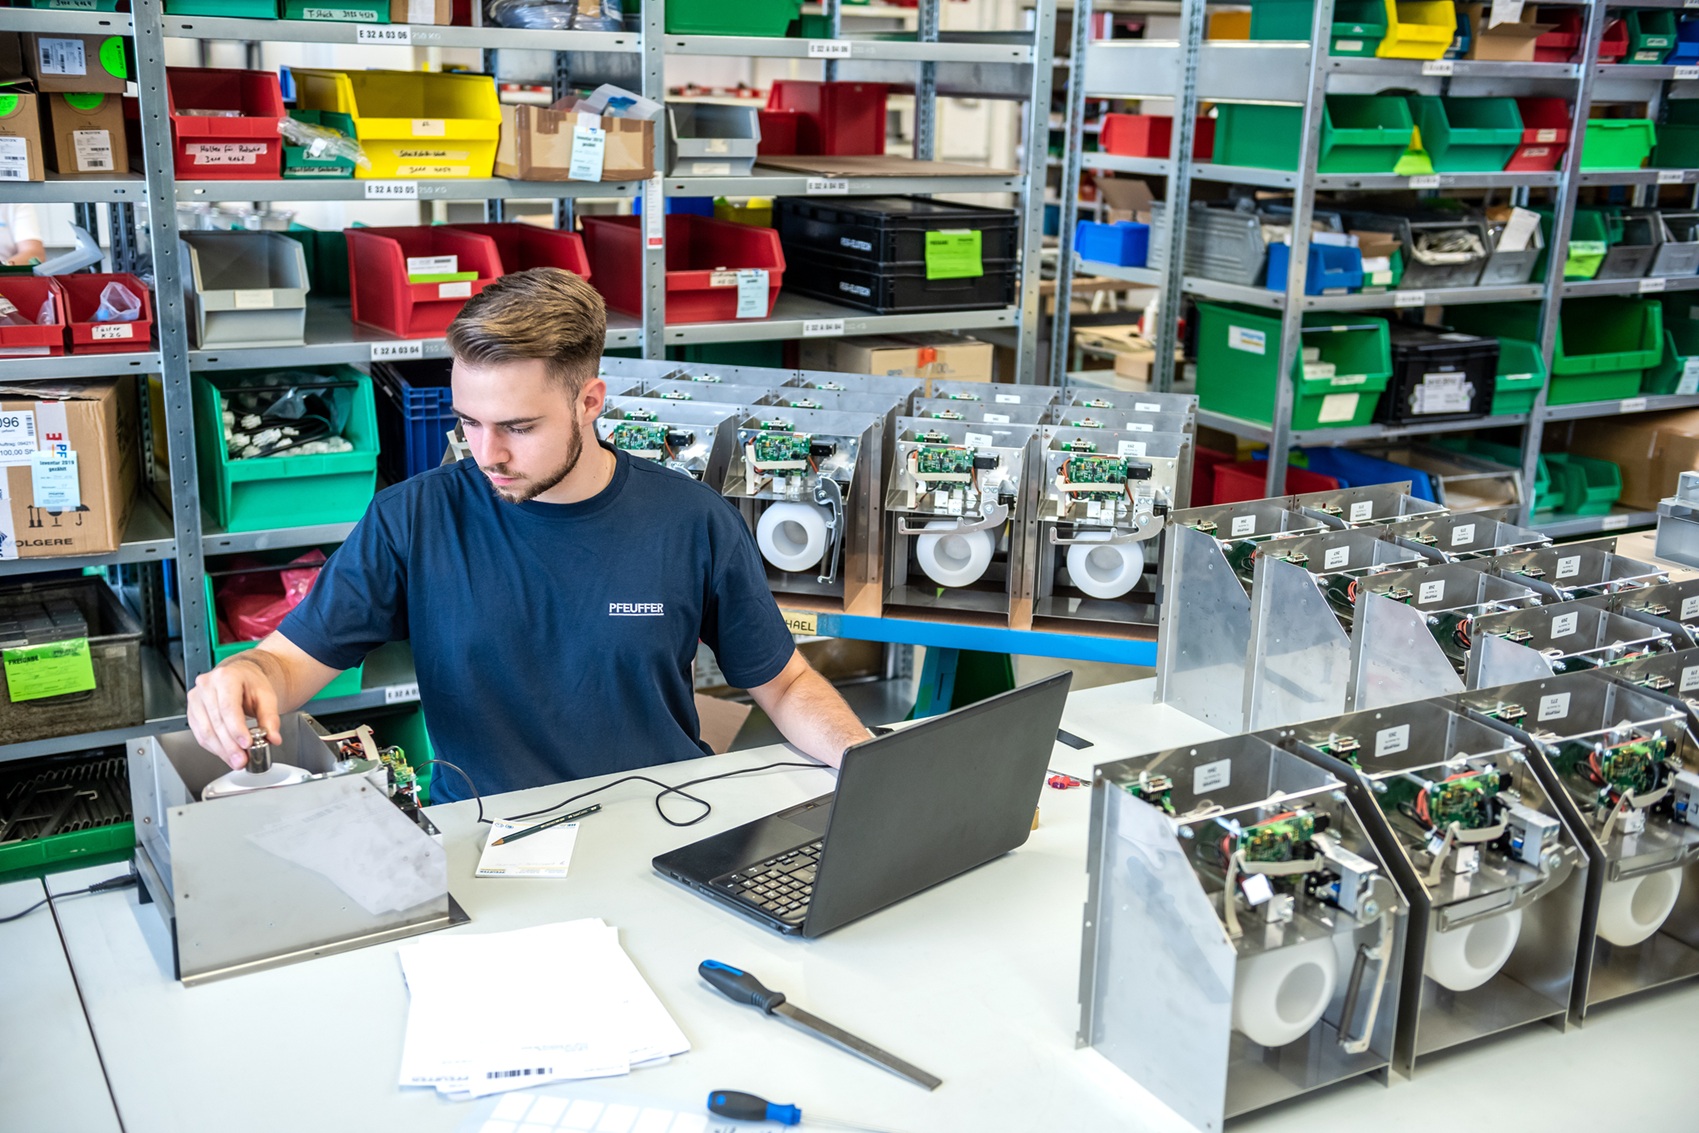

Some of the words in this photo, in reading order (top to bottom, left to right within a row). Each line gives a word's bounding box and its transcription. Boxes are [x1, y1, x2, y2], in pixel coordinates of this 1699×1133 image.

[366, 30, 376, 38] 32
[609, 603, 664, 613] PFEUFFER
[8, 655, 38, 665] FREIGABE
